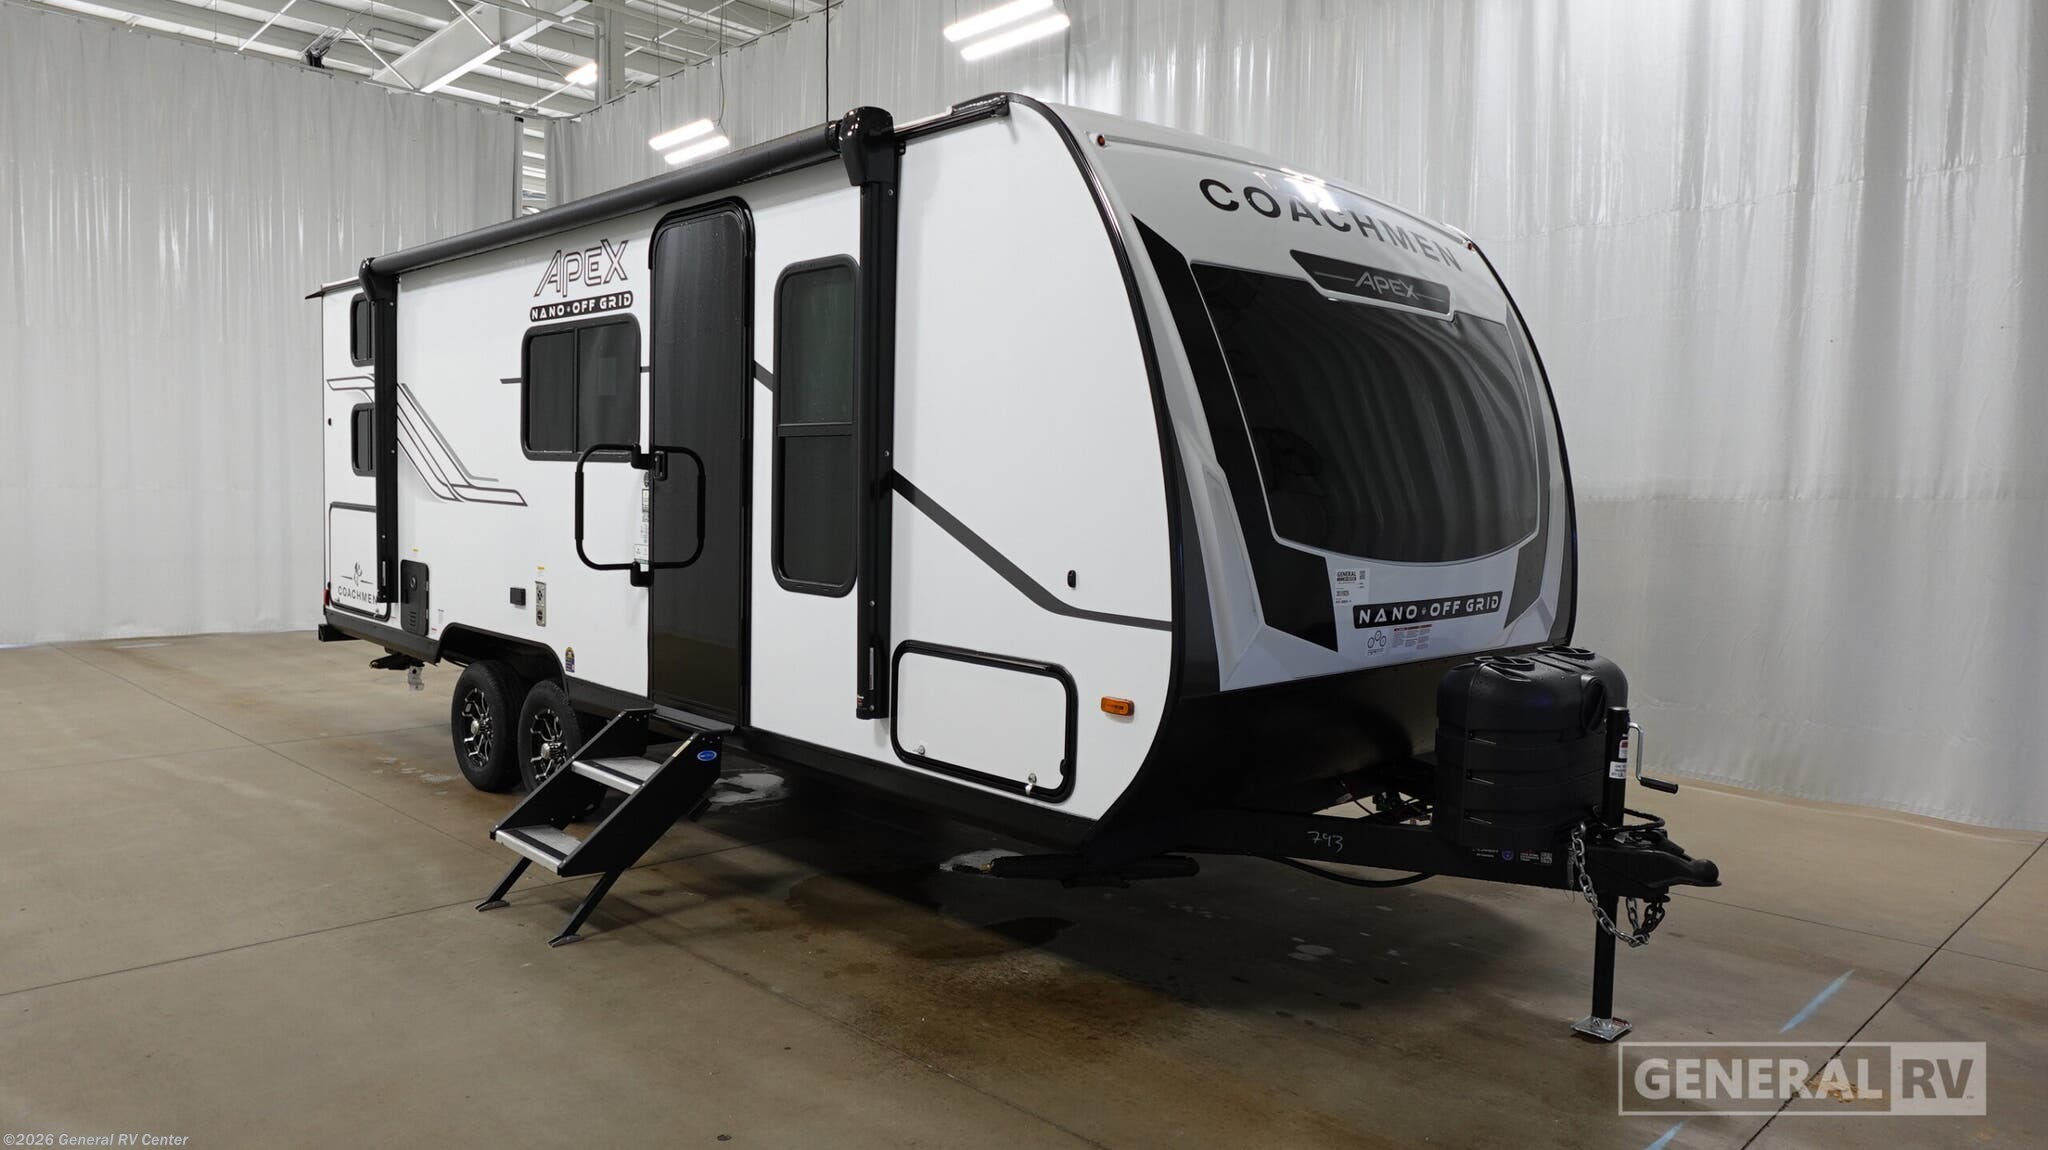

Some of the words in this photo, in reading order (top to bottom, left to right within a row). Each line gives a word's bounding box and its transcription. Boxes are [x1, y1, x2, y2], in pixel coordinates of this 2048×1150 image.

[1199, 178, 1463, 272] COACHMEN
[533, 238, 629, 298] APEX
[1355, 271, 1419, 300] APEX
[531, 304, 565, 320] NANO
[572, 299, 596, 314] OFF
[599, 293, 632, 309] GRID
[1358, 605, 1418, 625] NANO
[1429, 601, 1460, 617] OFF
[1465, 595, 1499, 612] GRID
